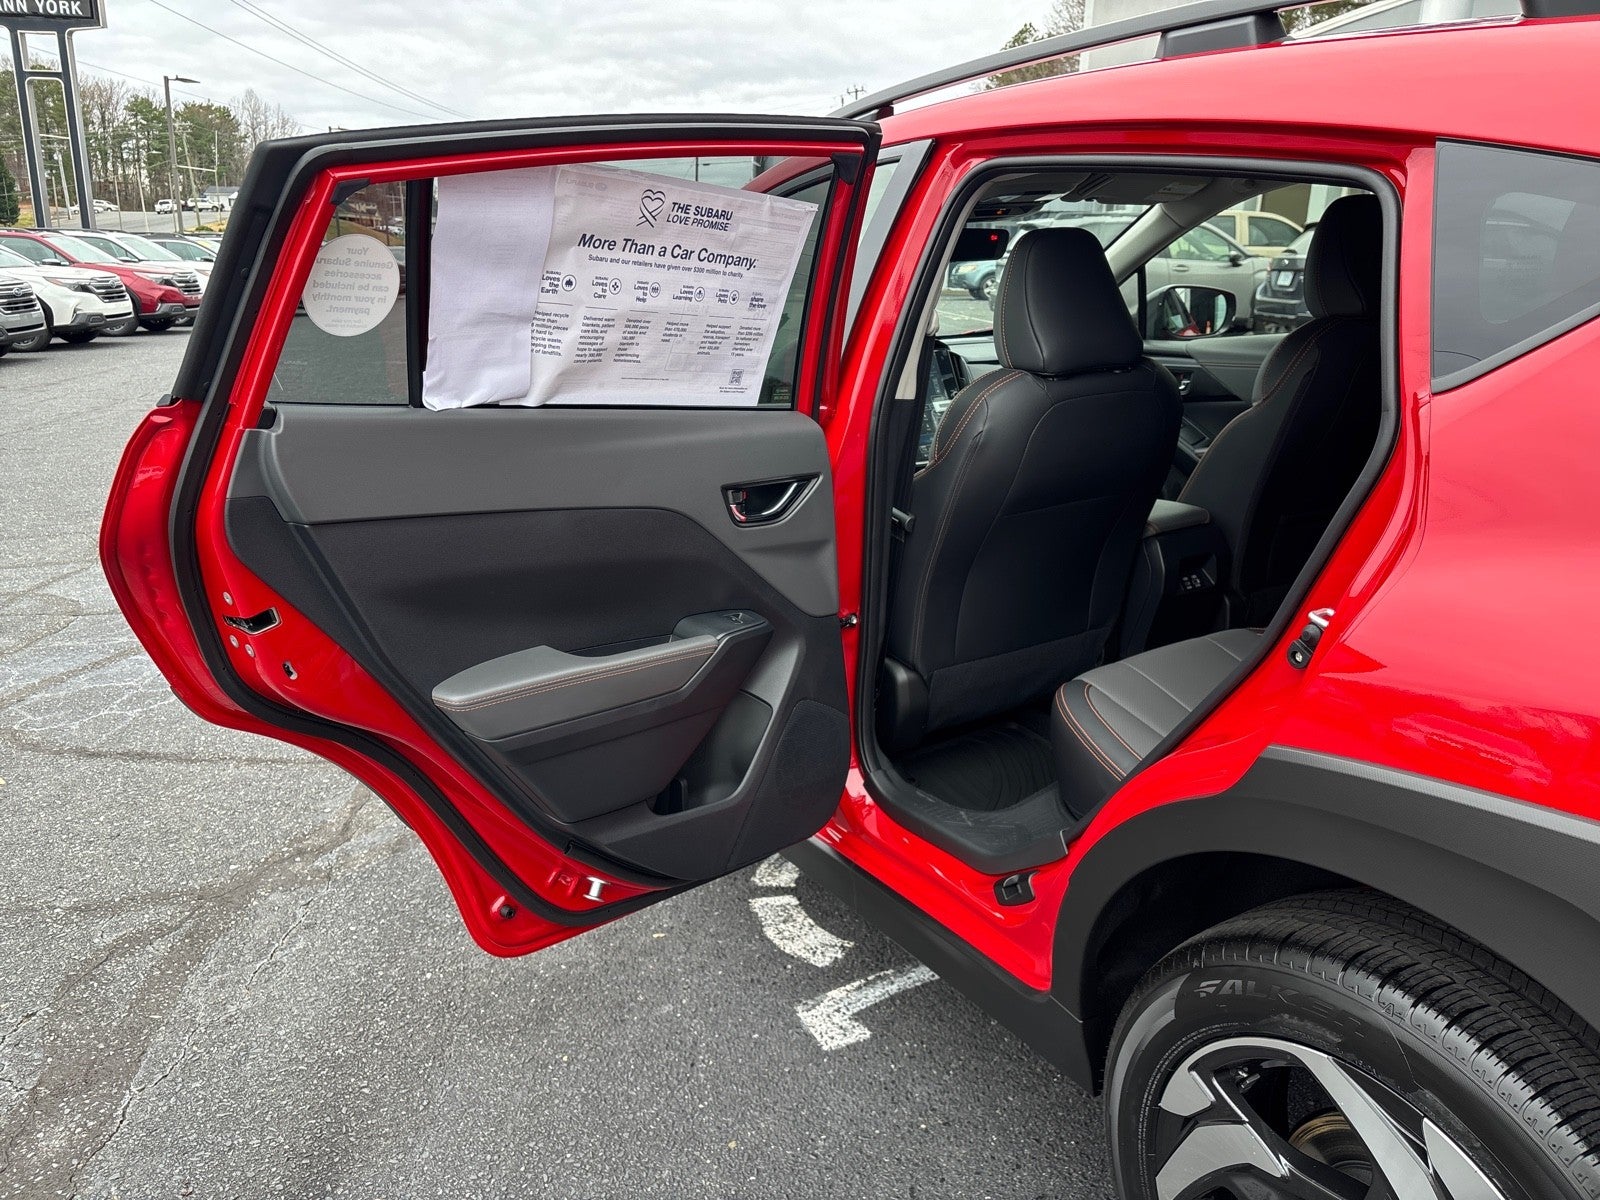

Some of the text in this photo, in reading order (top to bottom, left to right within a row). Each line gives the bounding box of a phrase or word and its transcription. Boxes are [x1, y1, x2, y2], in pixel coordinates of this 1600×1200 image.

[35, 0, 83, 15] YORK
[671, 202, 733, 221] THE SUBARU
[667, 213, 731, 232] LOVE PROMISE
[577, 233, 758, 269] More Than a Car Company.
[588, 254, 609, 263] Subaru
[632, 258, 653, 268] retailers
[654, 261, 666, 269] have
[667, 263, 681, 272] given
[706, 267, 721, 275] million
[542, 274, 560, 282] Loves
[592, 280, 608, 288] Loves
[594, 292, 606, 300] Care
[672, 294, 692, 302] Learning
